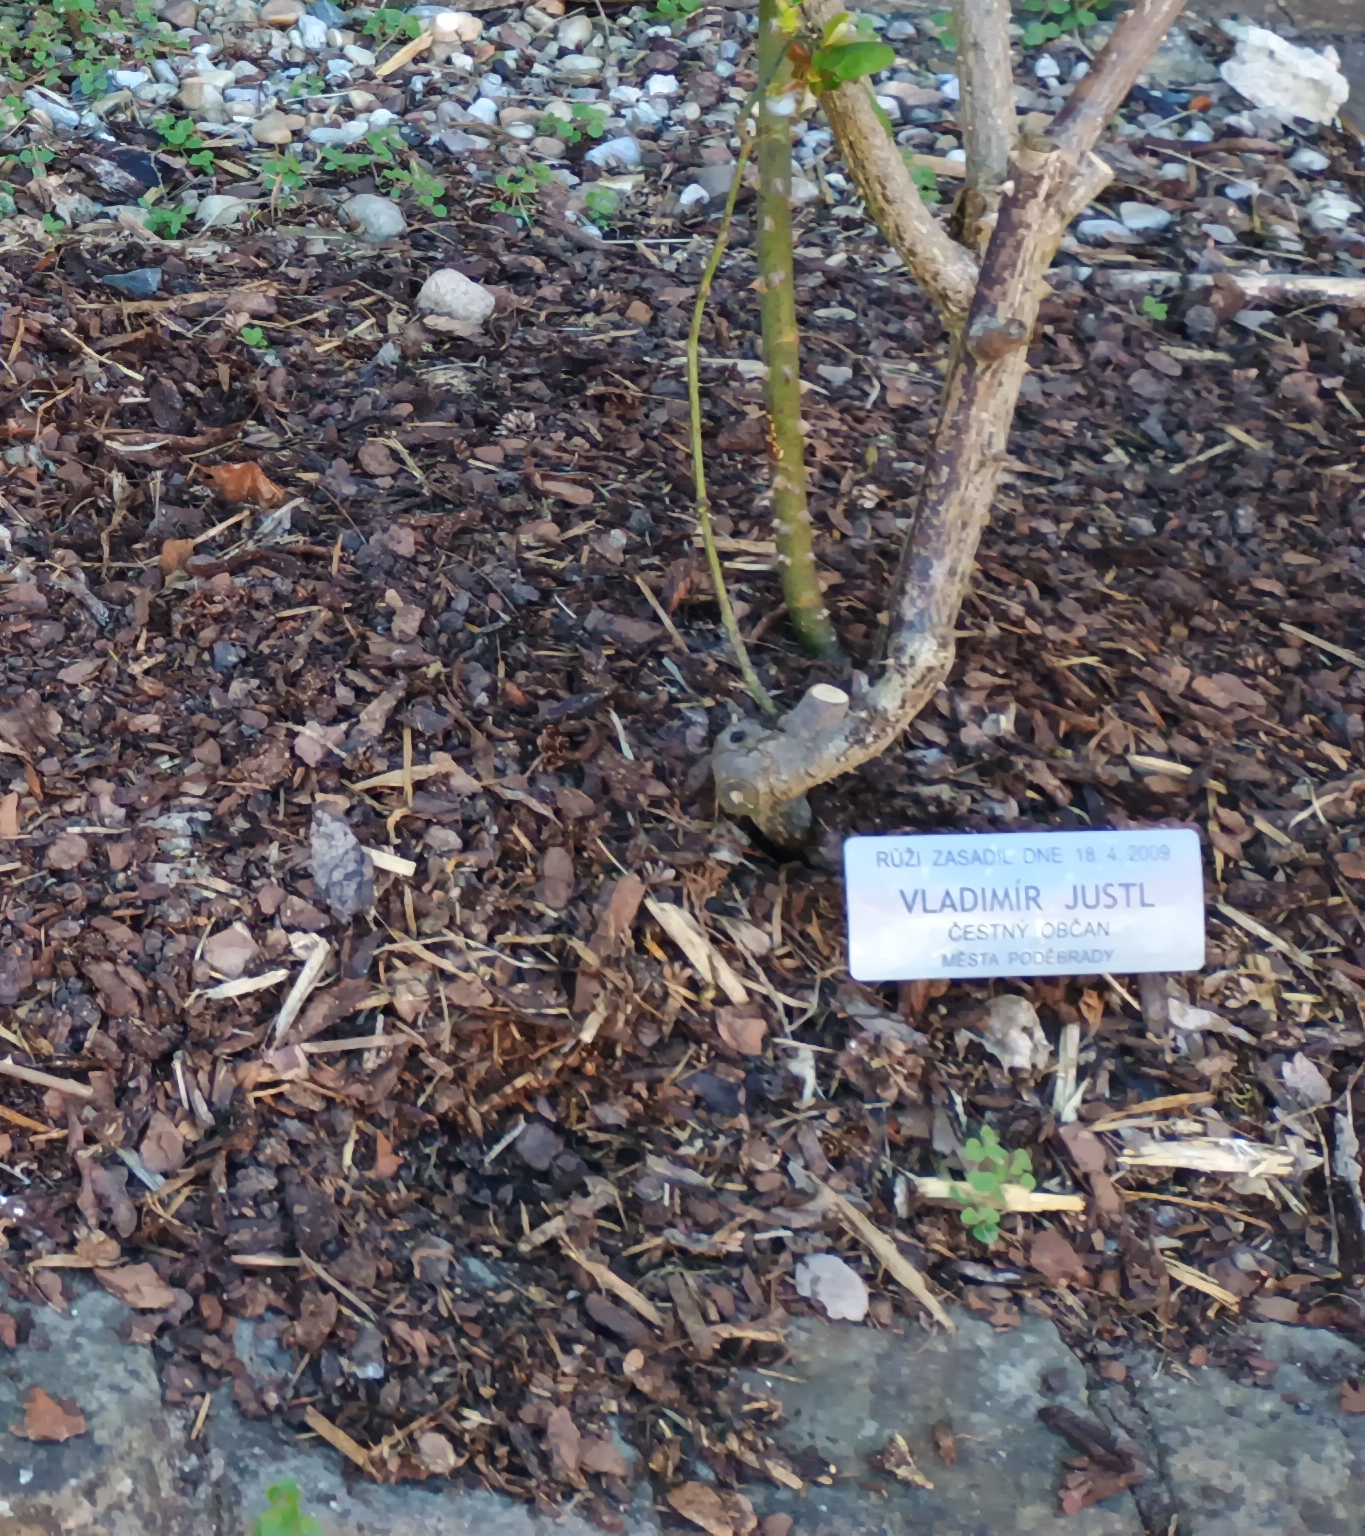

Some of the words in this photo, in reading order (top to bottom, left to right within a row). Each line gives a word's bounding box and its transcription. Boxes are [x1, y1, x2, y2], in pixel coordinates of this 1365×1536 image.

[876, 847, 921, 868] RŮŽI
[932, 848, 1013, 867] ZASADIL
[1023, 846, 1063, 864] DNE
[1128, 844, 1170, 862] 2009
[899, 878, 1043, 914] VLADIMÍR
[1064, 882, 1156, 910] JUSTL
[948, 919, 1029, 942] ČESTNÝ
[1041, 918, 1110, 939] OBČAN
[941, 950, 1000, 968] MĚSTA
[1007, 948, 1114, 966] PODĚBRADY
